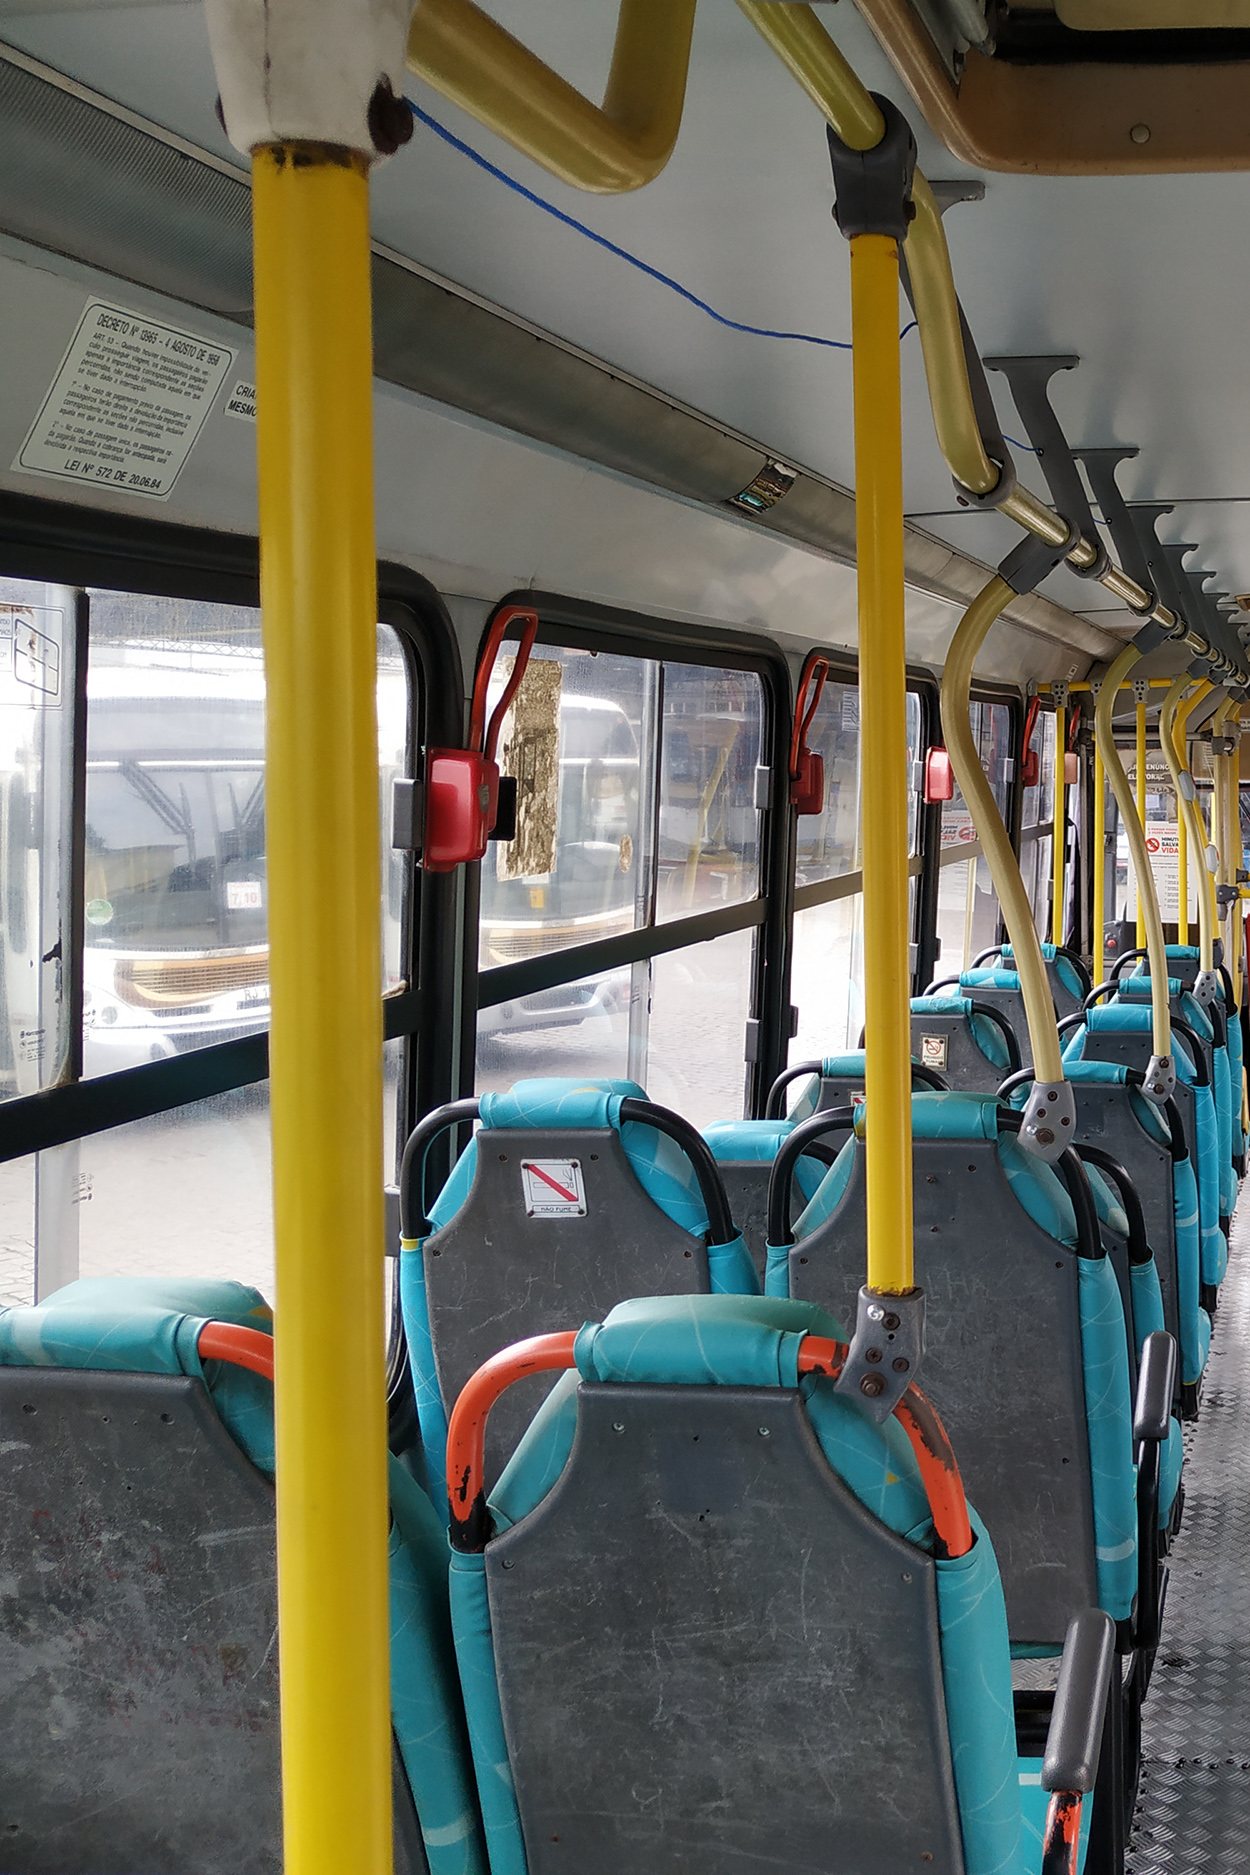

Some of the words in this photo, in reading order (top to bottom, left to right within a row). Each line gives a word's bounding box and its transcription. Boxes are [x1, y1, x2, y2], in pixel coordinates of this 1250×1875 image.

[97, 314, 129, 334] DECRETO
[129, 325, 140, 336] Nº
[165, 338, 171, 348] 4
[171, 340, 197, 357] AGOSTO
[196, 348, 207, 361] DE
[64, 459, 81, 471] LEI
[81, 463, 95, 474] Nº
[96, 466, 113, 478] 572
[113, 470, 128, 482] DE
[128, 474, 162, 489] 20.06.84
